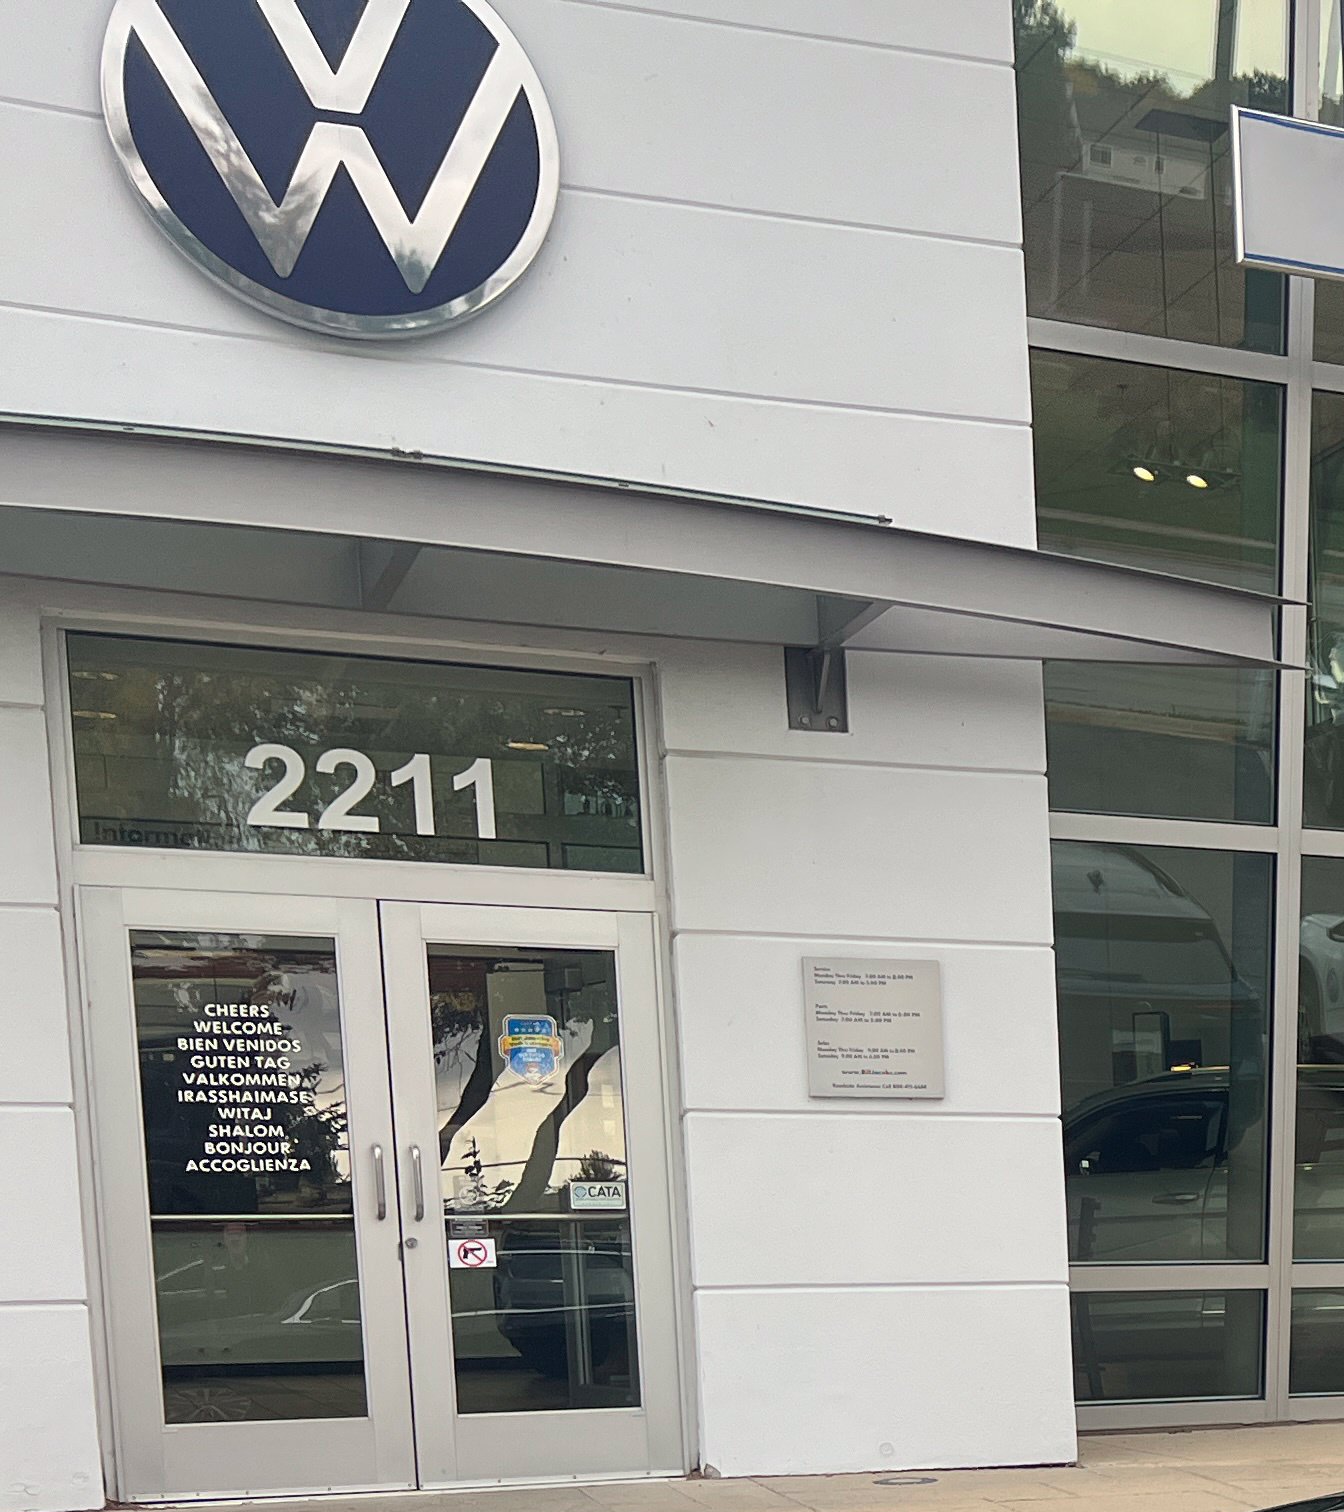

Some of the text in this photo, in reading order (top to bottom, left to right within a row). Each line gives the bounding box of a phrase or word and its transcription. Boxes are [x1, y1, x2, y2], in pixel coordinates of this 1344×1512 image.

[243, 742, 498, 840] 2211
[204, 1003, 270, 1018] CHEERS
[193, 1021, 283, 1036] WELCOME
[177, 1038, 302, 1053] BIEN VENIDOS
[190, 1055, 291, 1070] GUTEN TAG
[182, 1072, 302, 1087] VALKOMMEN
[177, 1090, 310, 1104] IRASSHAIMASE
[217, 1107, 272, 1121] WITAJ
[208, 1124, 285, 1138] SHALOM
[204, 1141, 291, 1155] BONJOUR
[185, 1158, 312, 1173] ACCOGLIENZA
[587, 1185, 622, 1198] CATA
